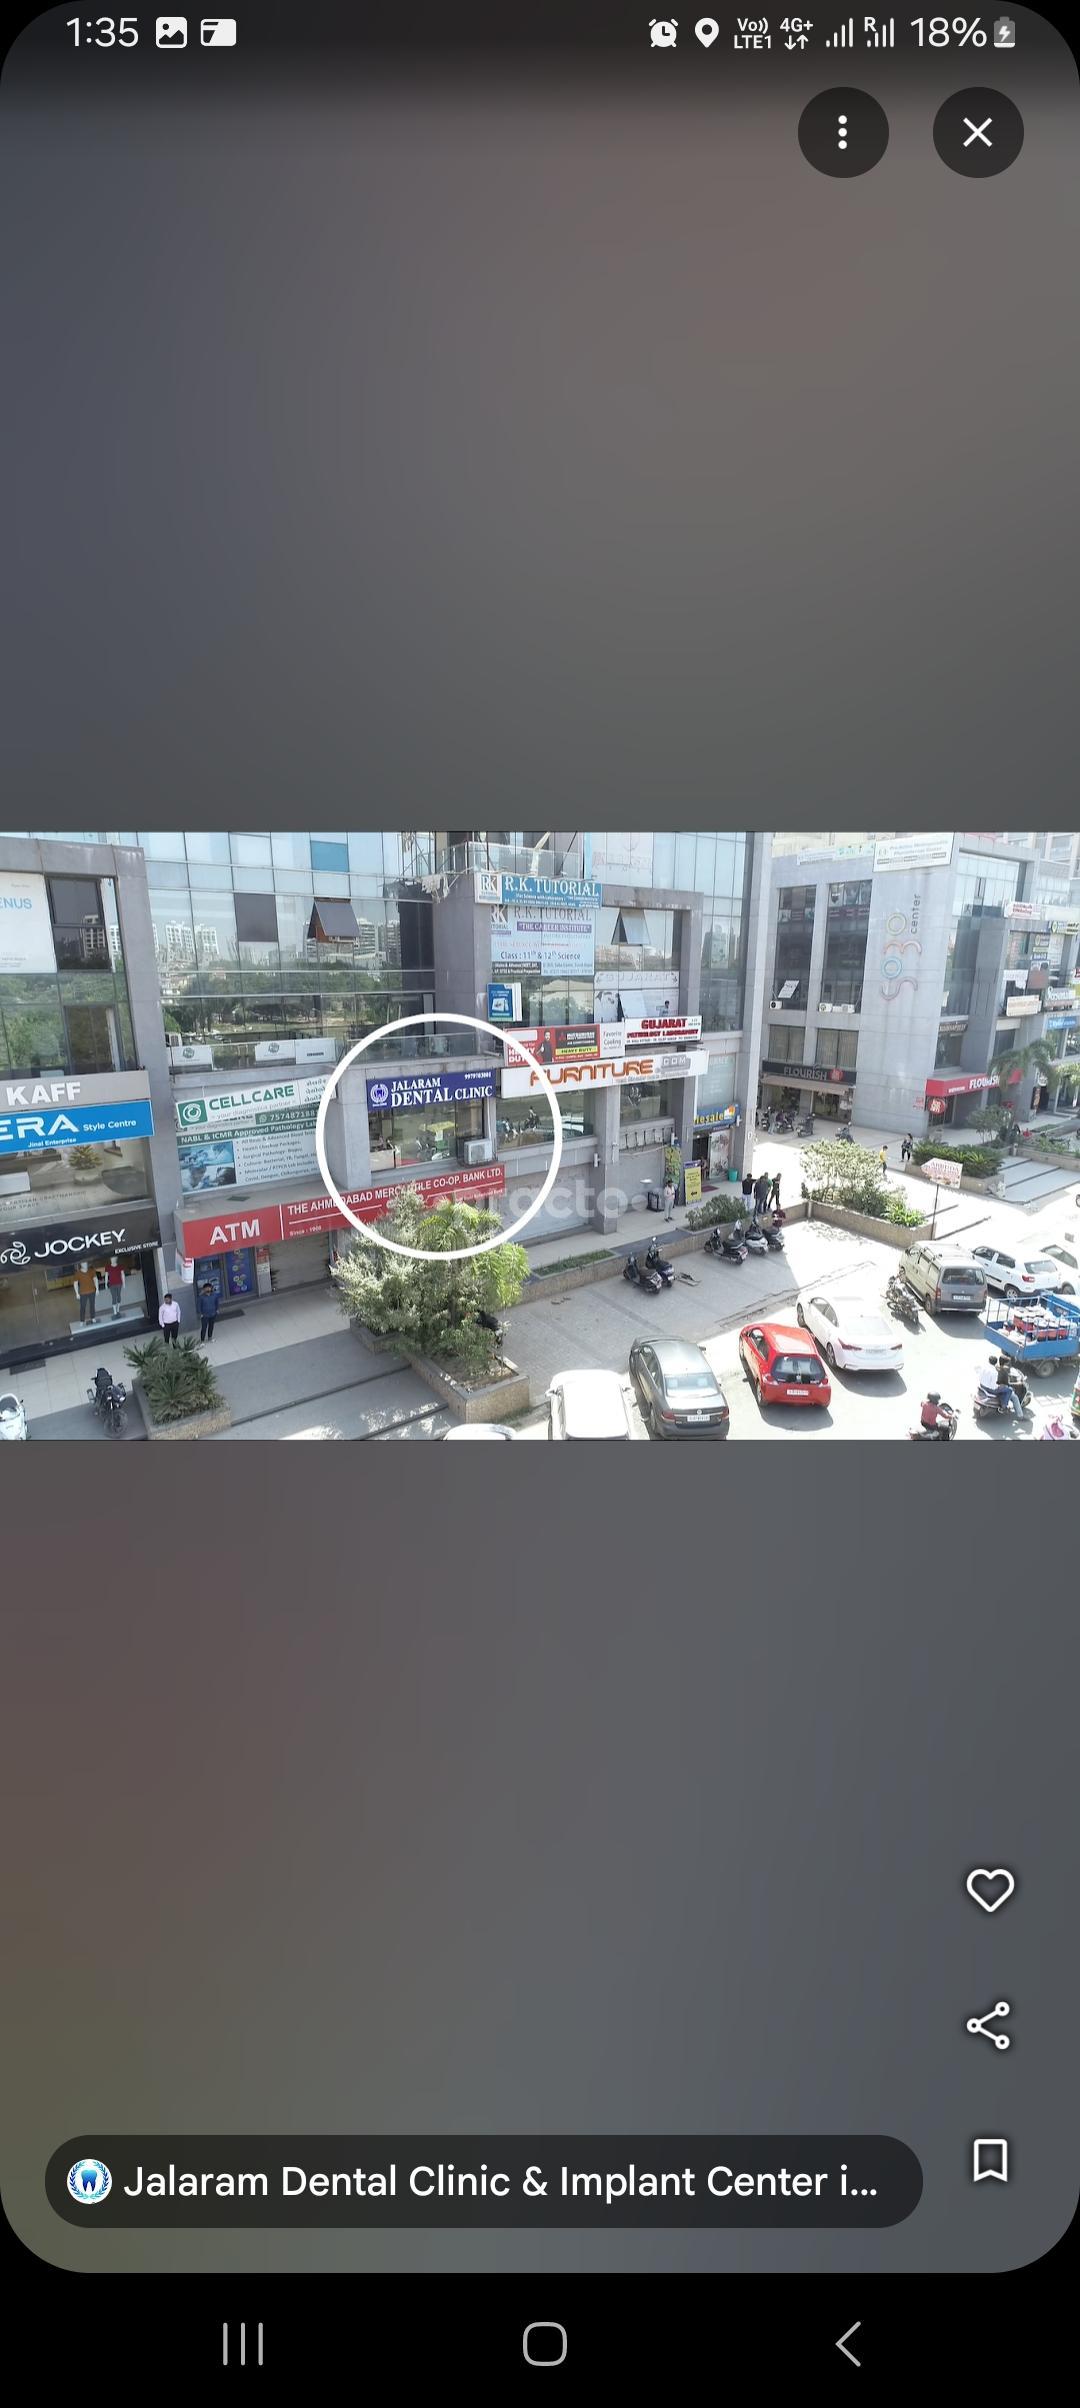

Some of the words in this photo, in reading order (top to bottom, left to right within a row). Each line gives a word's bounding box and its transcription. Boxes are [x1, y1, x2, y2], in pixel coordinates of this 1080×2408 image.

[505, 876, 532, 892] R.K.
[534, 878, 599, 897] TUTORIAL
[538, 907, 591, 920] TUTORIAL
[501, 951, 518, 960] Class
[557, 951, 581, 960] Science
[641, 1018, 687, 1030] GUJARAT
[530, 1059, 654, 1086] FURNITURE
[784, 1066, 827, 1080] FLOURISH
[6, 1081, 81, 1106] KAFF
[391, 1077, 441, 1092] JALARAM
[209, 1085, 294, 1111] CELLCARE
[391, 1087, 453, 1108] DENTAL
[455, 1085, 493, 1100] CLINIC
[83, 1122, 106, 1133] Style
[108, 1119, 137, 1129] Centre
[181, 1135, 202, 1144] NABL
[212, 1131, 233, 1139] ICMR
[234, 1126, 269, 1138] Approved
[270, 1122, 304, 1134] Pathology
[287, 1203, 308, 1216] THE
[463, 1170, 485, 1184] BANK
[486, 1167, 503, 1178] LTD.
[34, 1228, 125, 1258] JOCKEY
[210, 1219, 260, 1246] ATM
[115, 1244, 142, 1254] EXCLUSIVE
[143, 1241, 159, 1249] STORE
